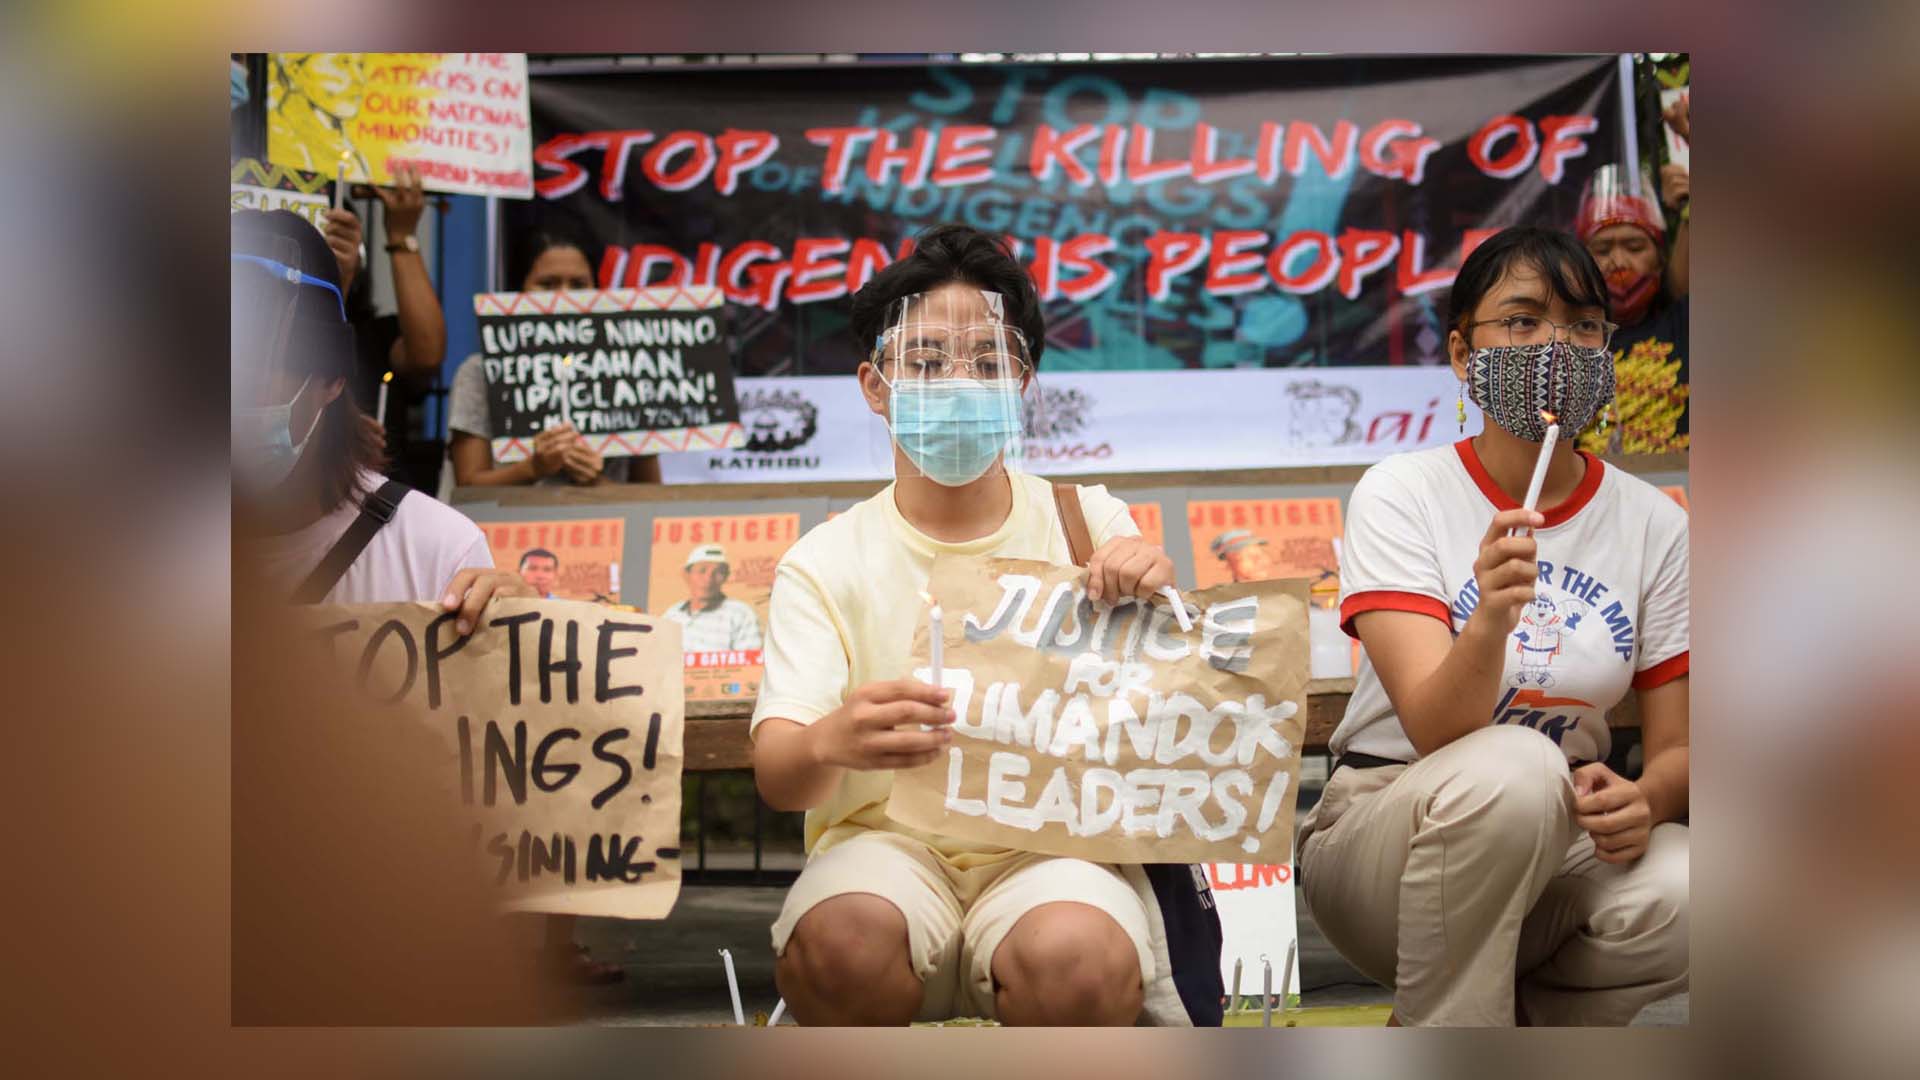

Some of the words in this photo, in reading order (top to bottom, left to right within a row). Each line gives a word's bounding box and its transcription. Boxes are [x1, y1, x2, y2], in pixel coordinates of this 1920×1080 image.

[369, 64, 477, 94] ATTACKS
[483, 77, 522, 100] ON
[364, 92, 422, 116] OUR
[427, 100, 527, 130] NATIONAL
[357, 121, 511, 158] MINORITIES!
[533, 128, 779, 200] STOP
[805, 125, 997, 195] THE
[1029, 119, 1441, 187] KILLING
[1468, 115, 1598, 185] OF
[1145, 224, 1504, 300] PEOPL
[482, 318, 597, 354] LUPANG
[708, 456, 821, 469] KATRIBU
[652, 517, 796, 545] JUSTICE!
[1190, 502, 1336, 527] JUSTICE!
[963, 574, 1260, 672] JUSTICE
[1452, 578, 1480, 622] VOT
[1561, 565, 1608, 607] THE
[1600, 600, 1634, 662] MVP
[490, 611, 653, 705] THE
[1064, 653, 1155, 698] FOR
[944, 746, 1291, 854] LEADERS!
